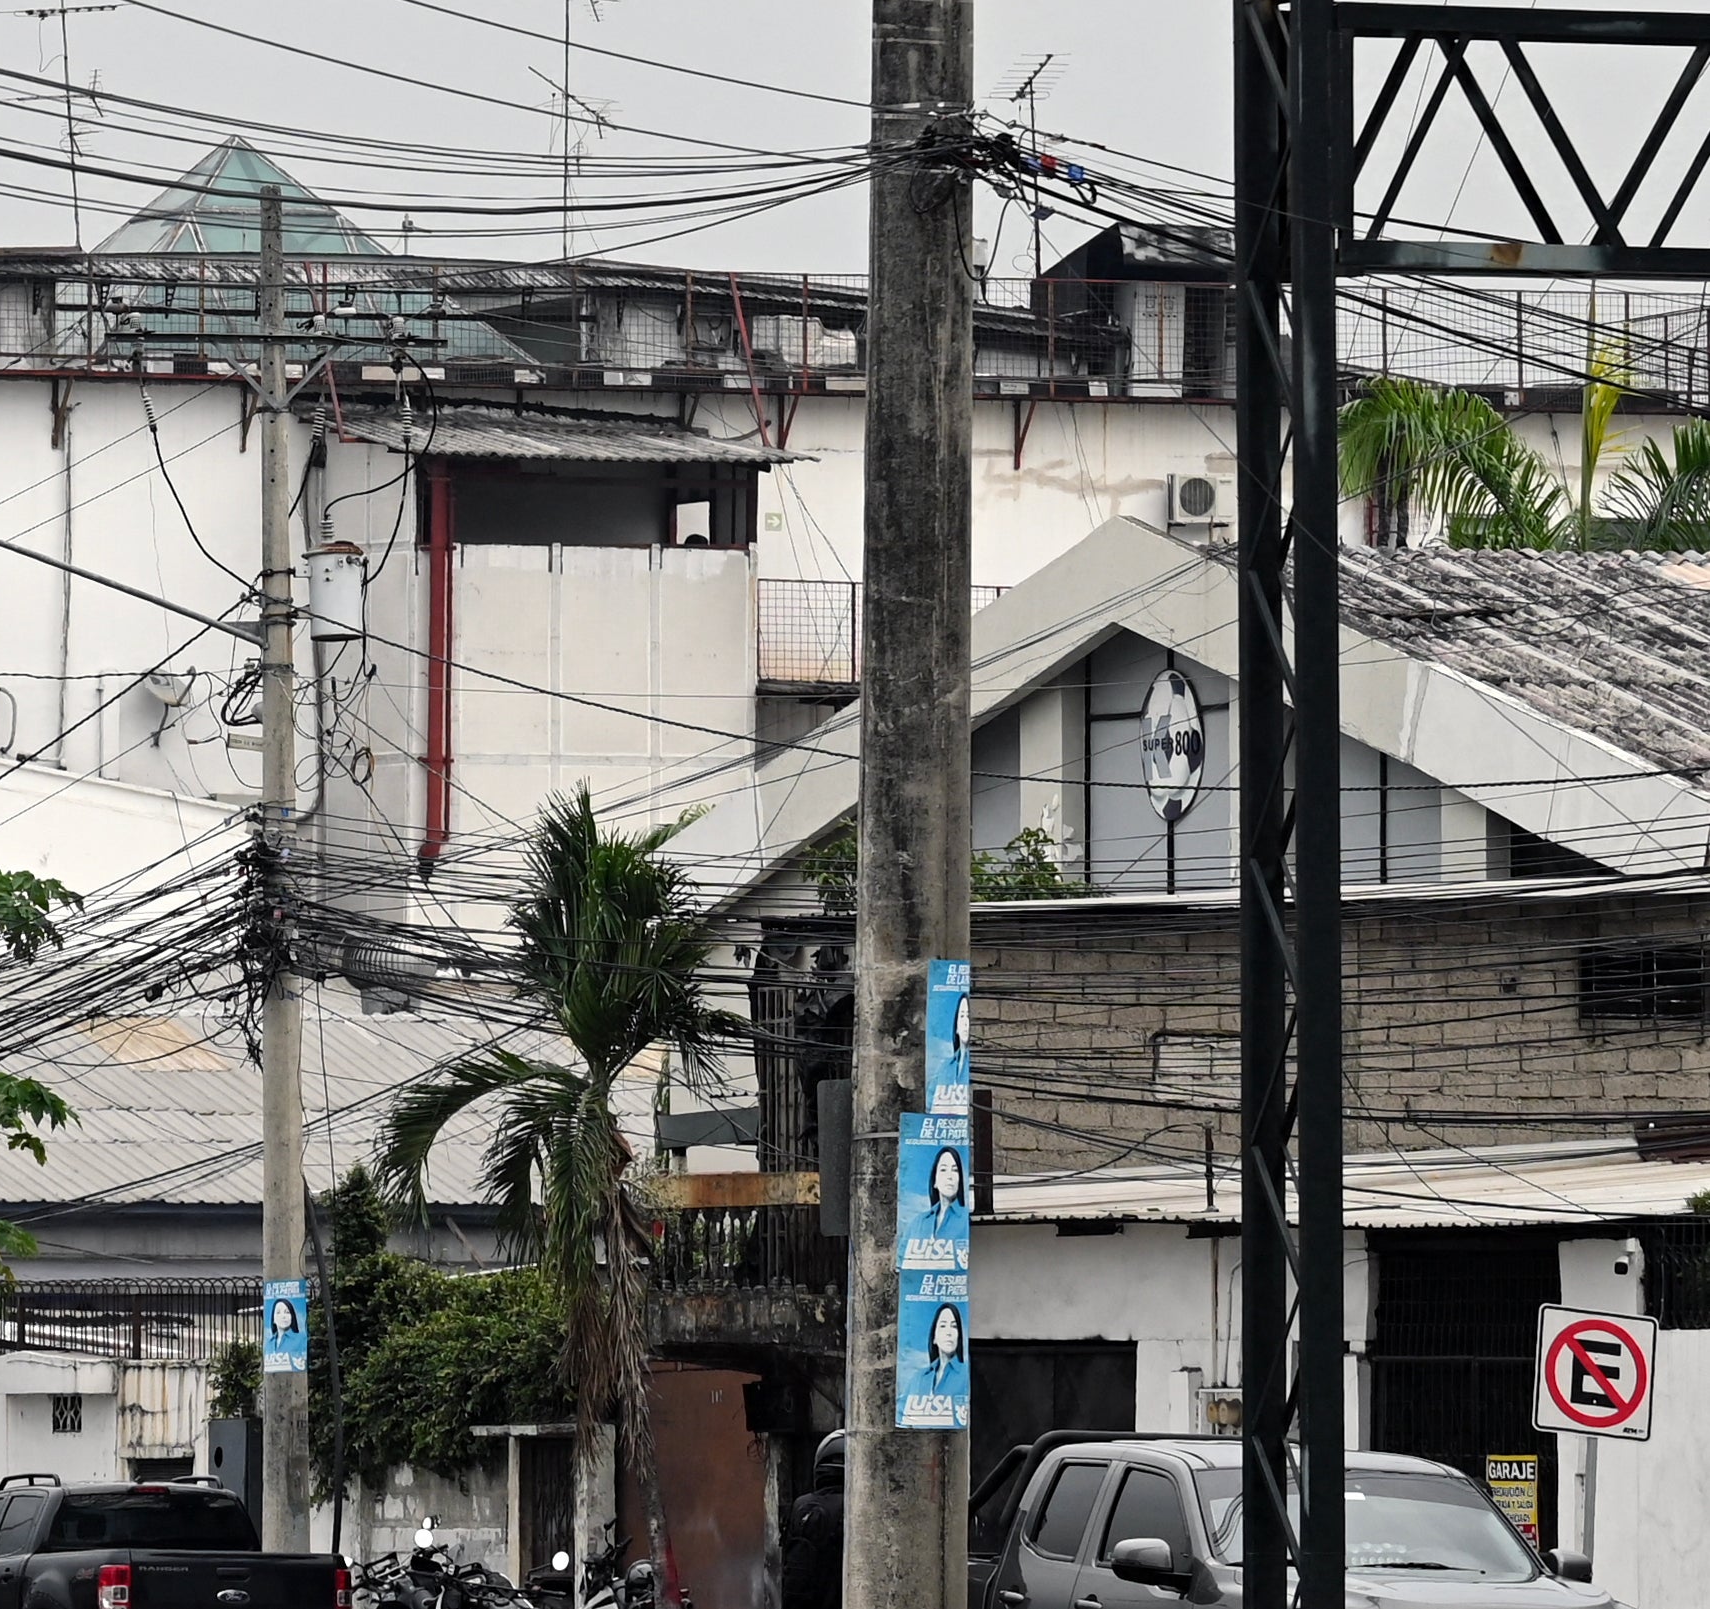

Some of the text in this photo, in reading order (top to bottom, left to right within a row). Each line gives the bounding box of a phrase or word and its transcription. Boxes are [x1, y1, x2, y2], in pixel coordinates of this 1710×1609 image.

[1142, 730, 1202, 756] SUPER 800
[1488, 1461, 1536, 1480] GARAJE
[138, 1565, 189, 1573] RANGER
